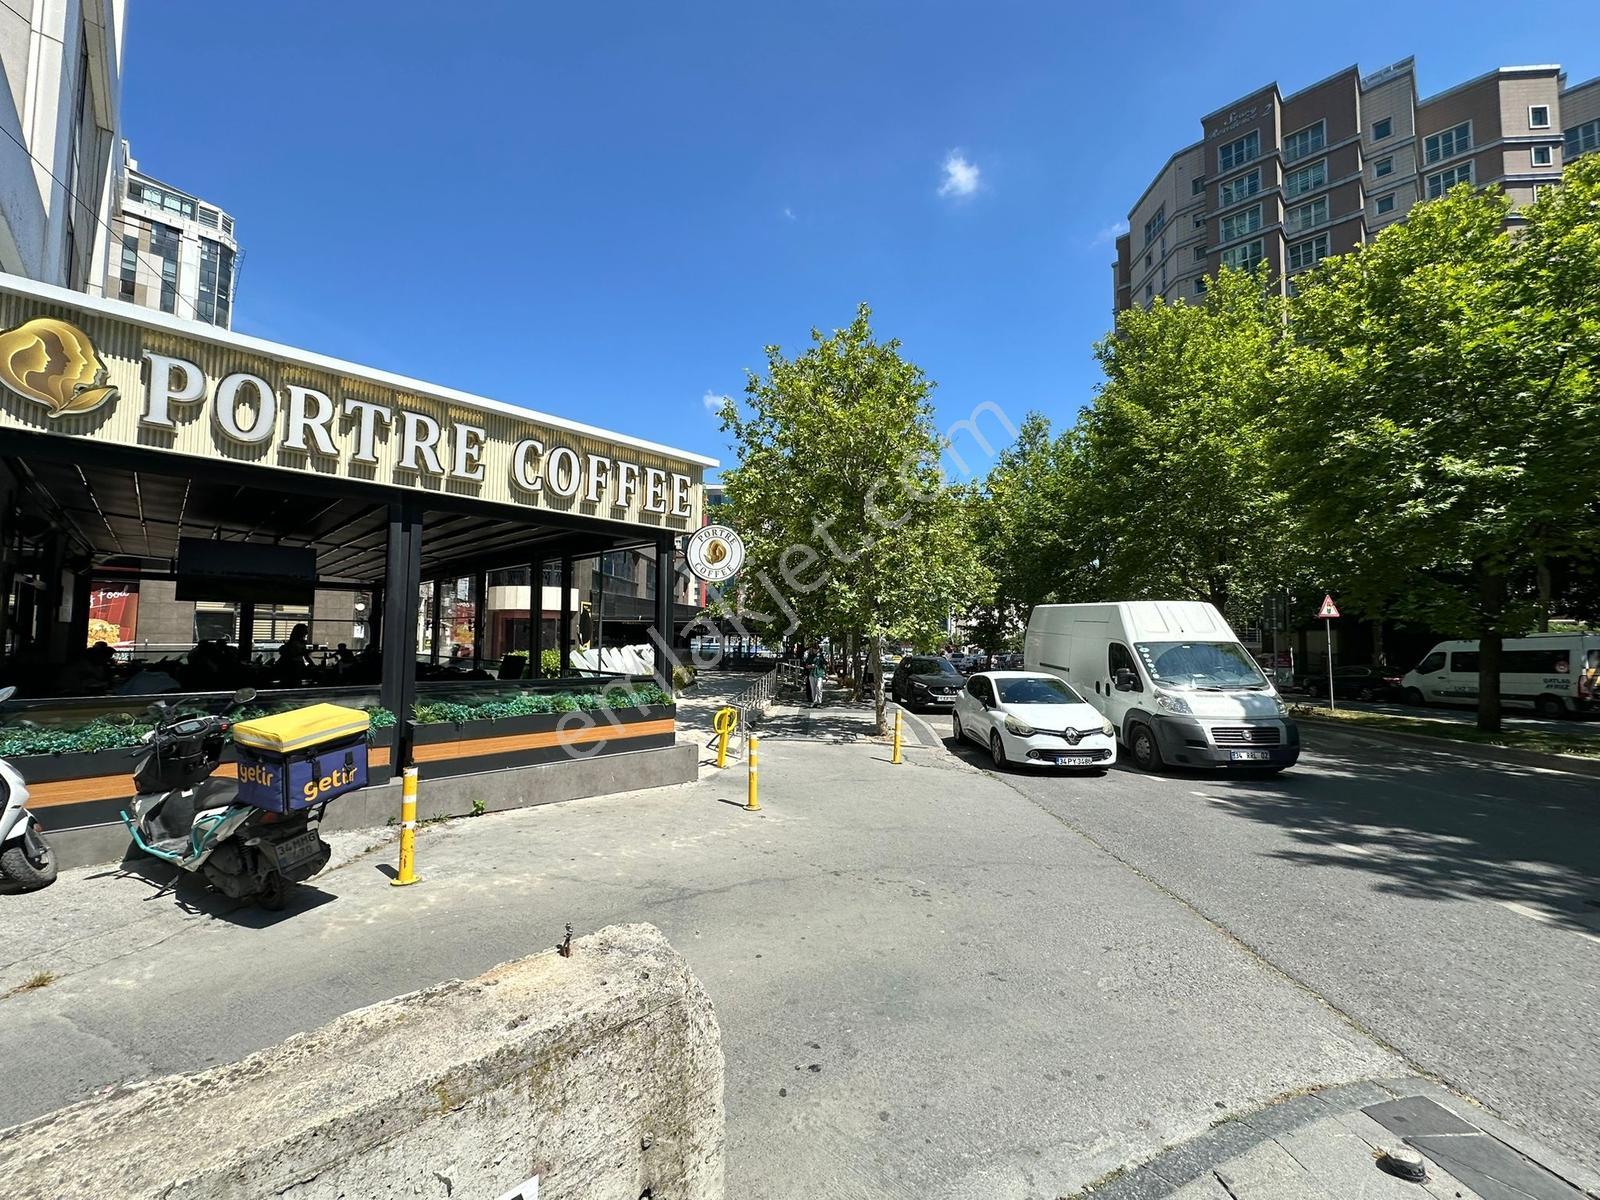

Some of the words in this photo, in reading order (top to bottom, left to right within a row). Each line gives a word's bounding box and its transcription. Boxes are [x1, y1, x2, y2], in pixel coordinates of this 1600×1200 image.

[142, 349, 485, 482] PORTRE
[512, 438, 692, 518] COFFEE
[697, 529, 736, 545] PORTRE
[694, 562, 735, 578] COFFEE
[239, 764, 273, 787] getir
[303, 767, 357, 801] getir
